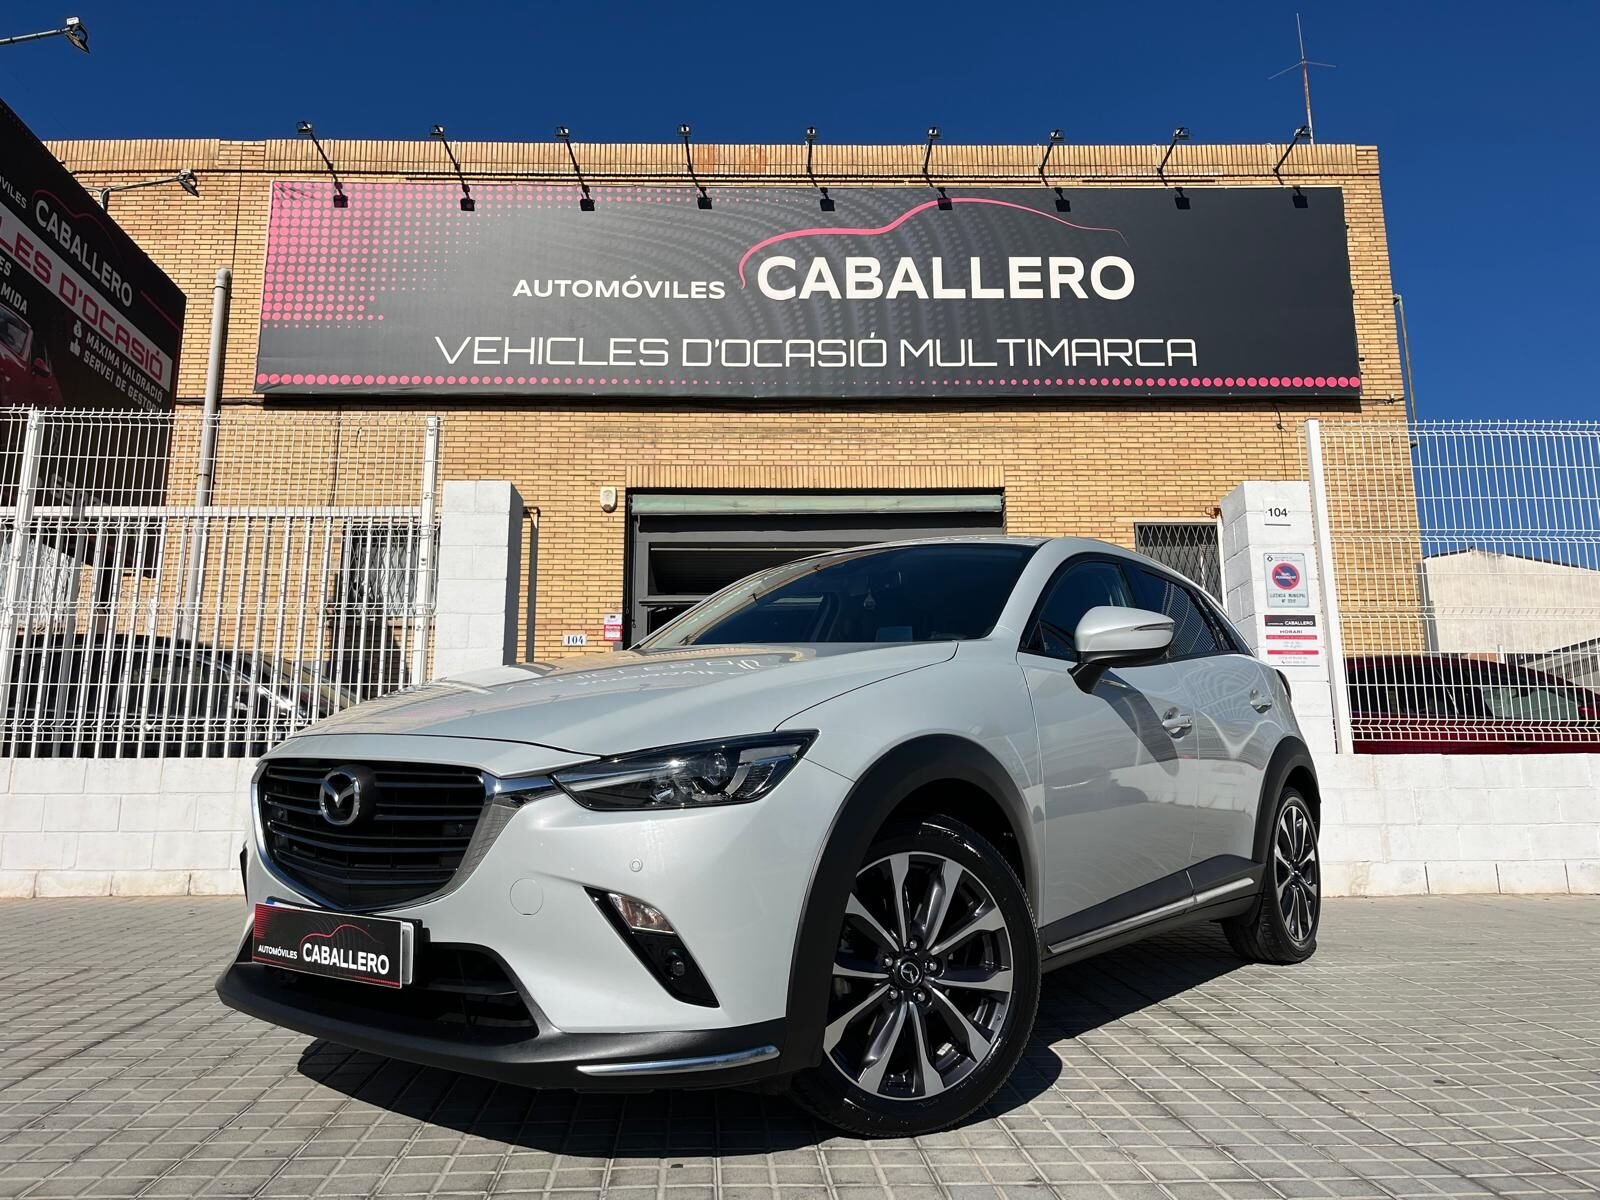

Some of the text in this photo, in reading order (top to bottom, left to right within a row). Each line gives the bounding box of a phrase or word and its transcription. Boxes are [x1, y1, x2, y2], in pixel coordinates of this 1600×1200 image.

[36, 199, 133, 308] CABALLERO
[512, 255, 1135, 301] AUTOMÓVILES CABALLERO
[1, 281, 28, 315] MIDA
[434, 332, 1198, 368] VEHICLES D'OCASIÓ MULTIMARCA
[83, 350, 114, 383] SERVEI
[115, 376, 126, 393] DE
[1267, 508, 1288, 517] 104
[567, 635, 583, 644] 104
[258, 943, 389, 974] AUTOMÓVILES CABALLERO
